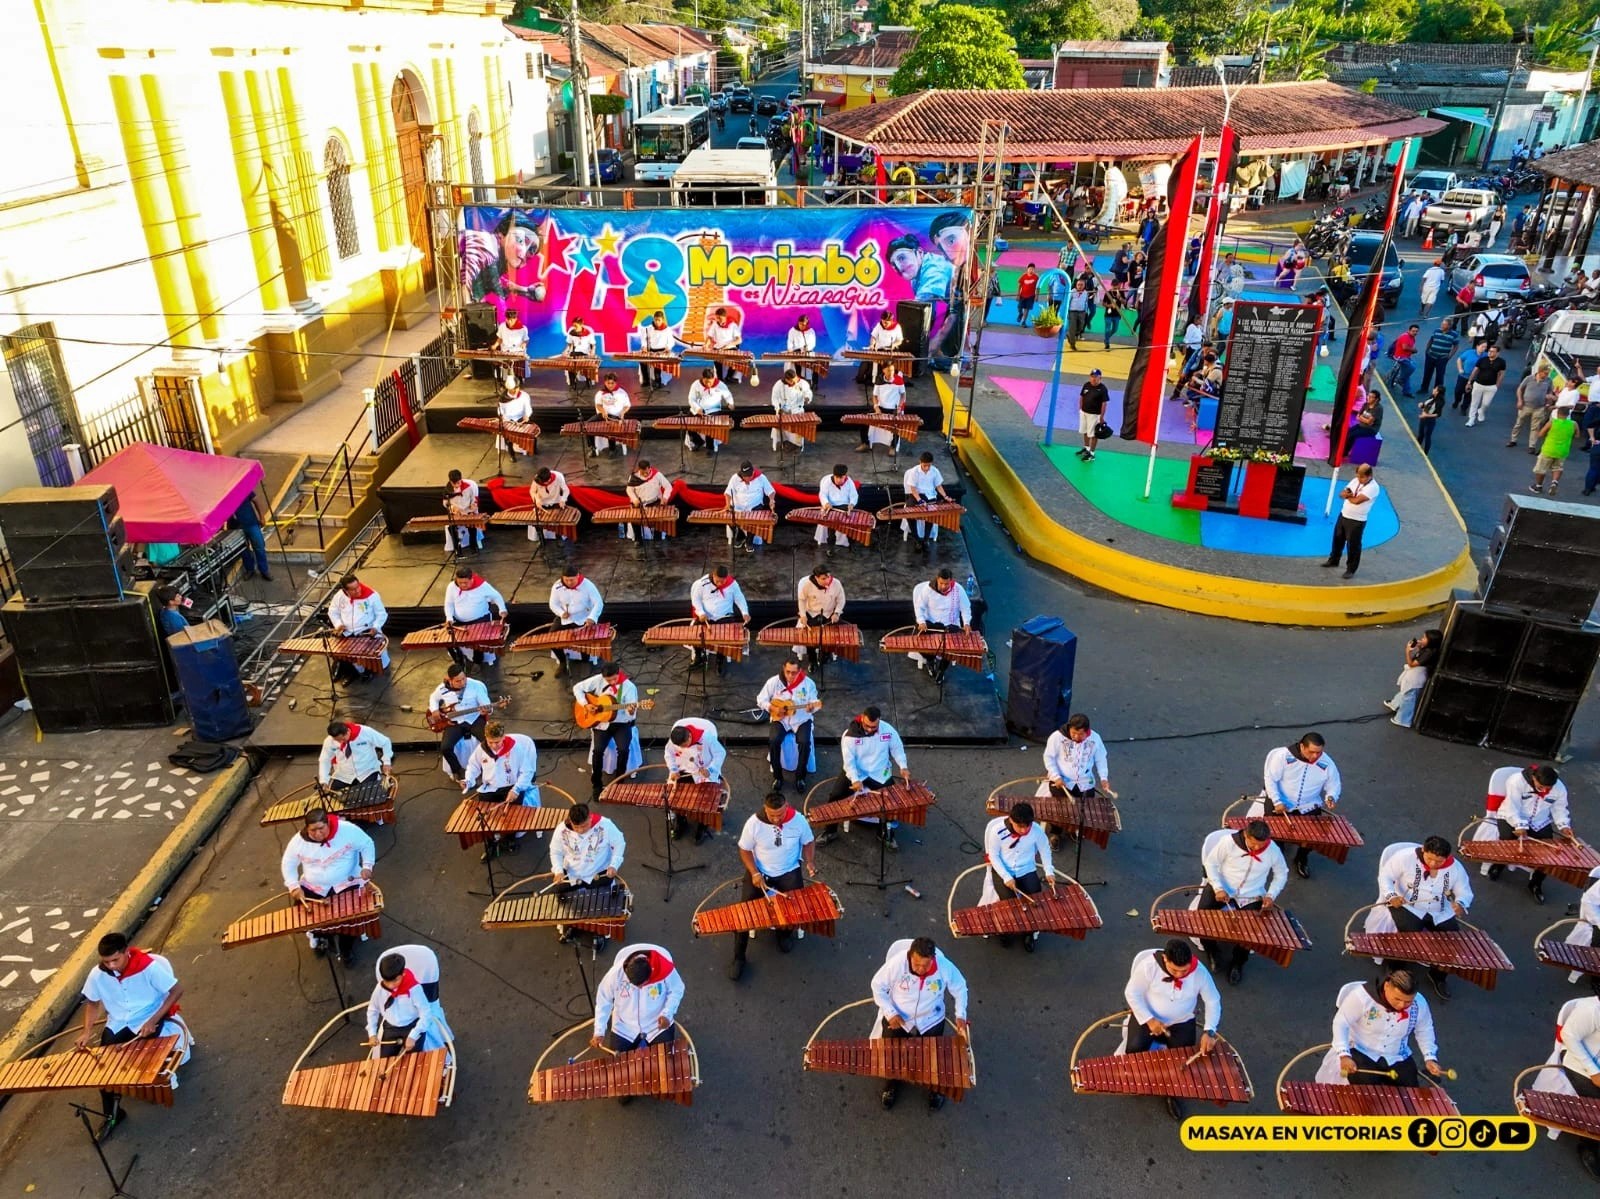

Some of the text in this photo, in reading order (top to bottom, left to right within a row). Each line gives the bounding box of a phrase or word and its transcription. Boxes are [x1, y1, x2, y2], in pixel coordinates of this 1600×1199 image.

[688, 242, 881, 286] Monimbó
[565, 236, 688, 353] 48
[744, 265, 886, 310] es Nicaragua
